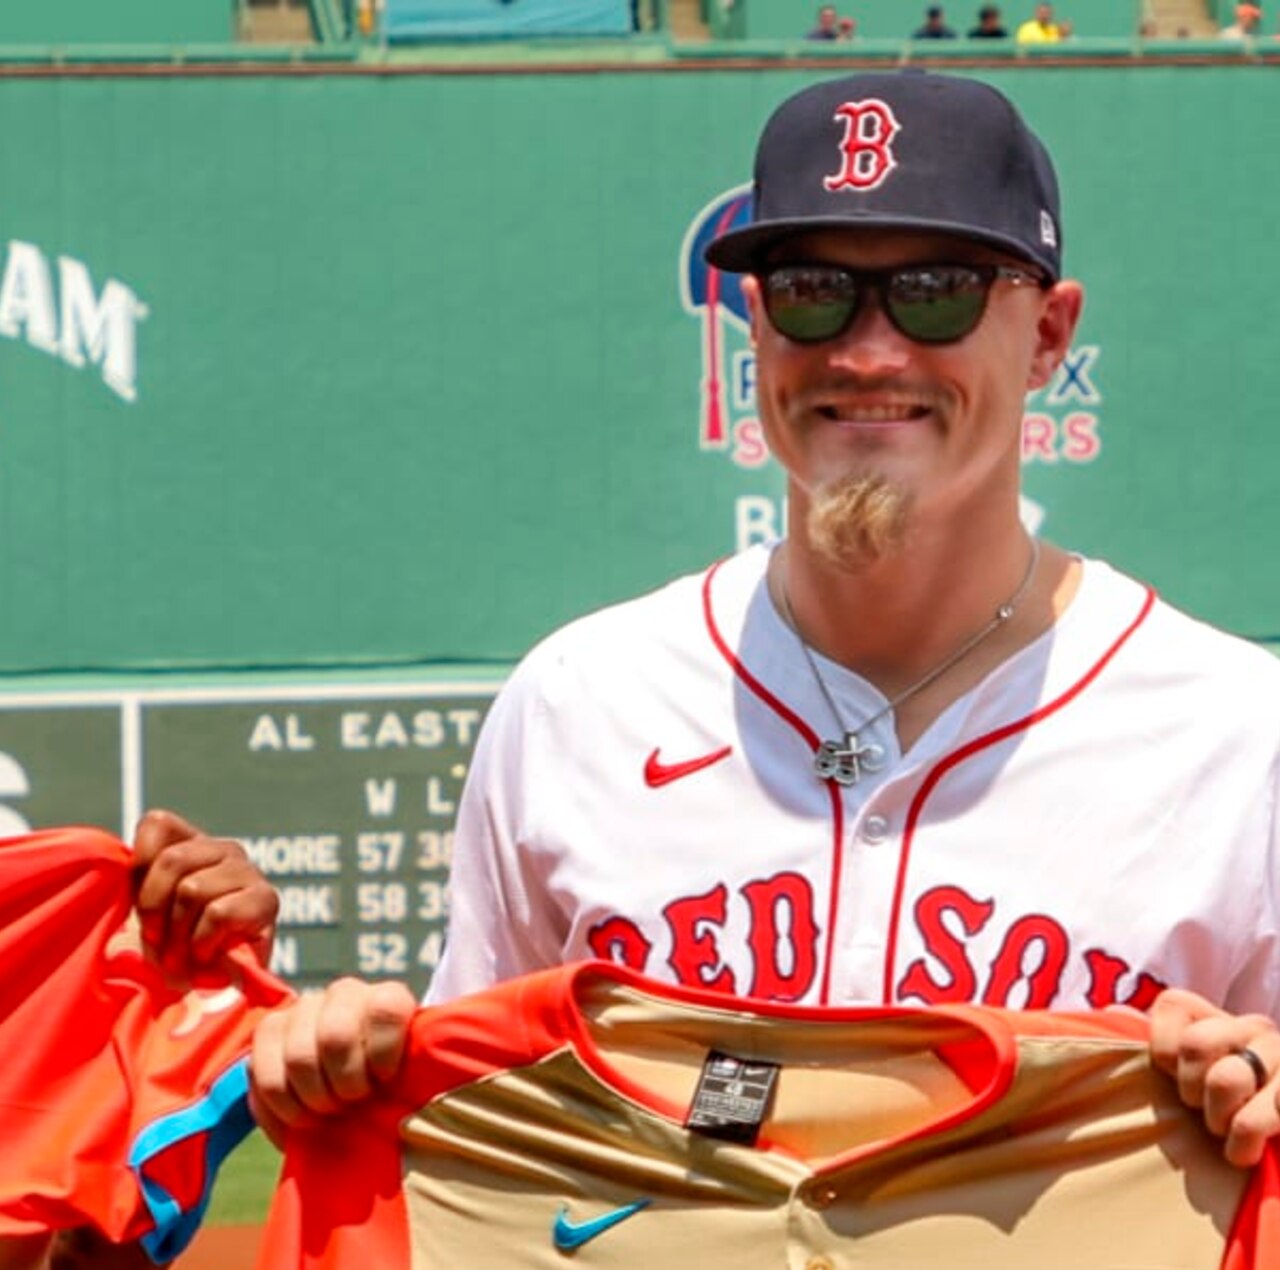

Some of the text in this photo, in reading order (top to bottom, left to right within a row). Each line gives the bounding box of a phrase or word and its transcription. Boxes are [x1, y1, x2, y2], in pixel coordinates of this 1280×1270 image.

[824, 99, 901, 190] B
[248, 710, 480, 750] AL EAST
[365, 777, 455, 816] W L
[357, 832, 405, 872] 57
[357, 882, 408, 923] 58
[357, 932, 408, 973] 52
